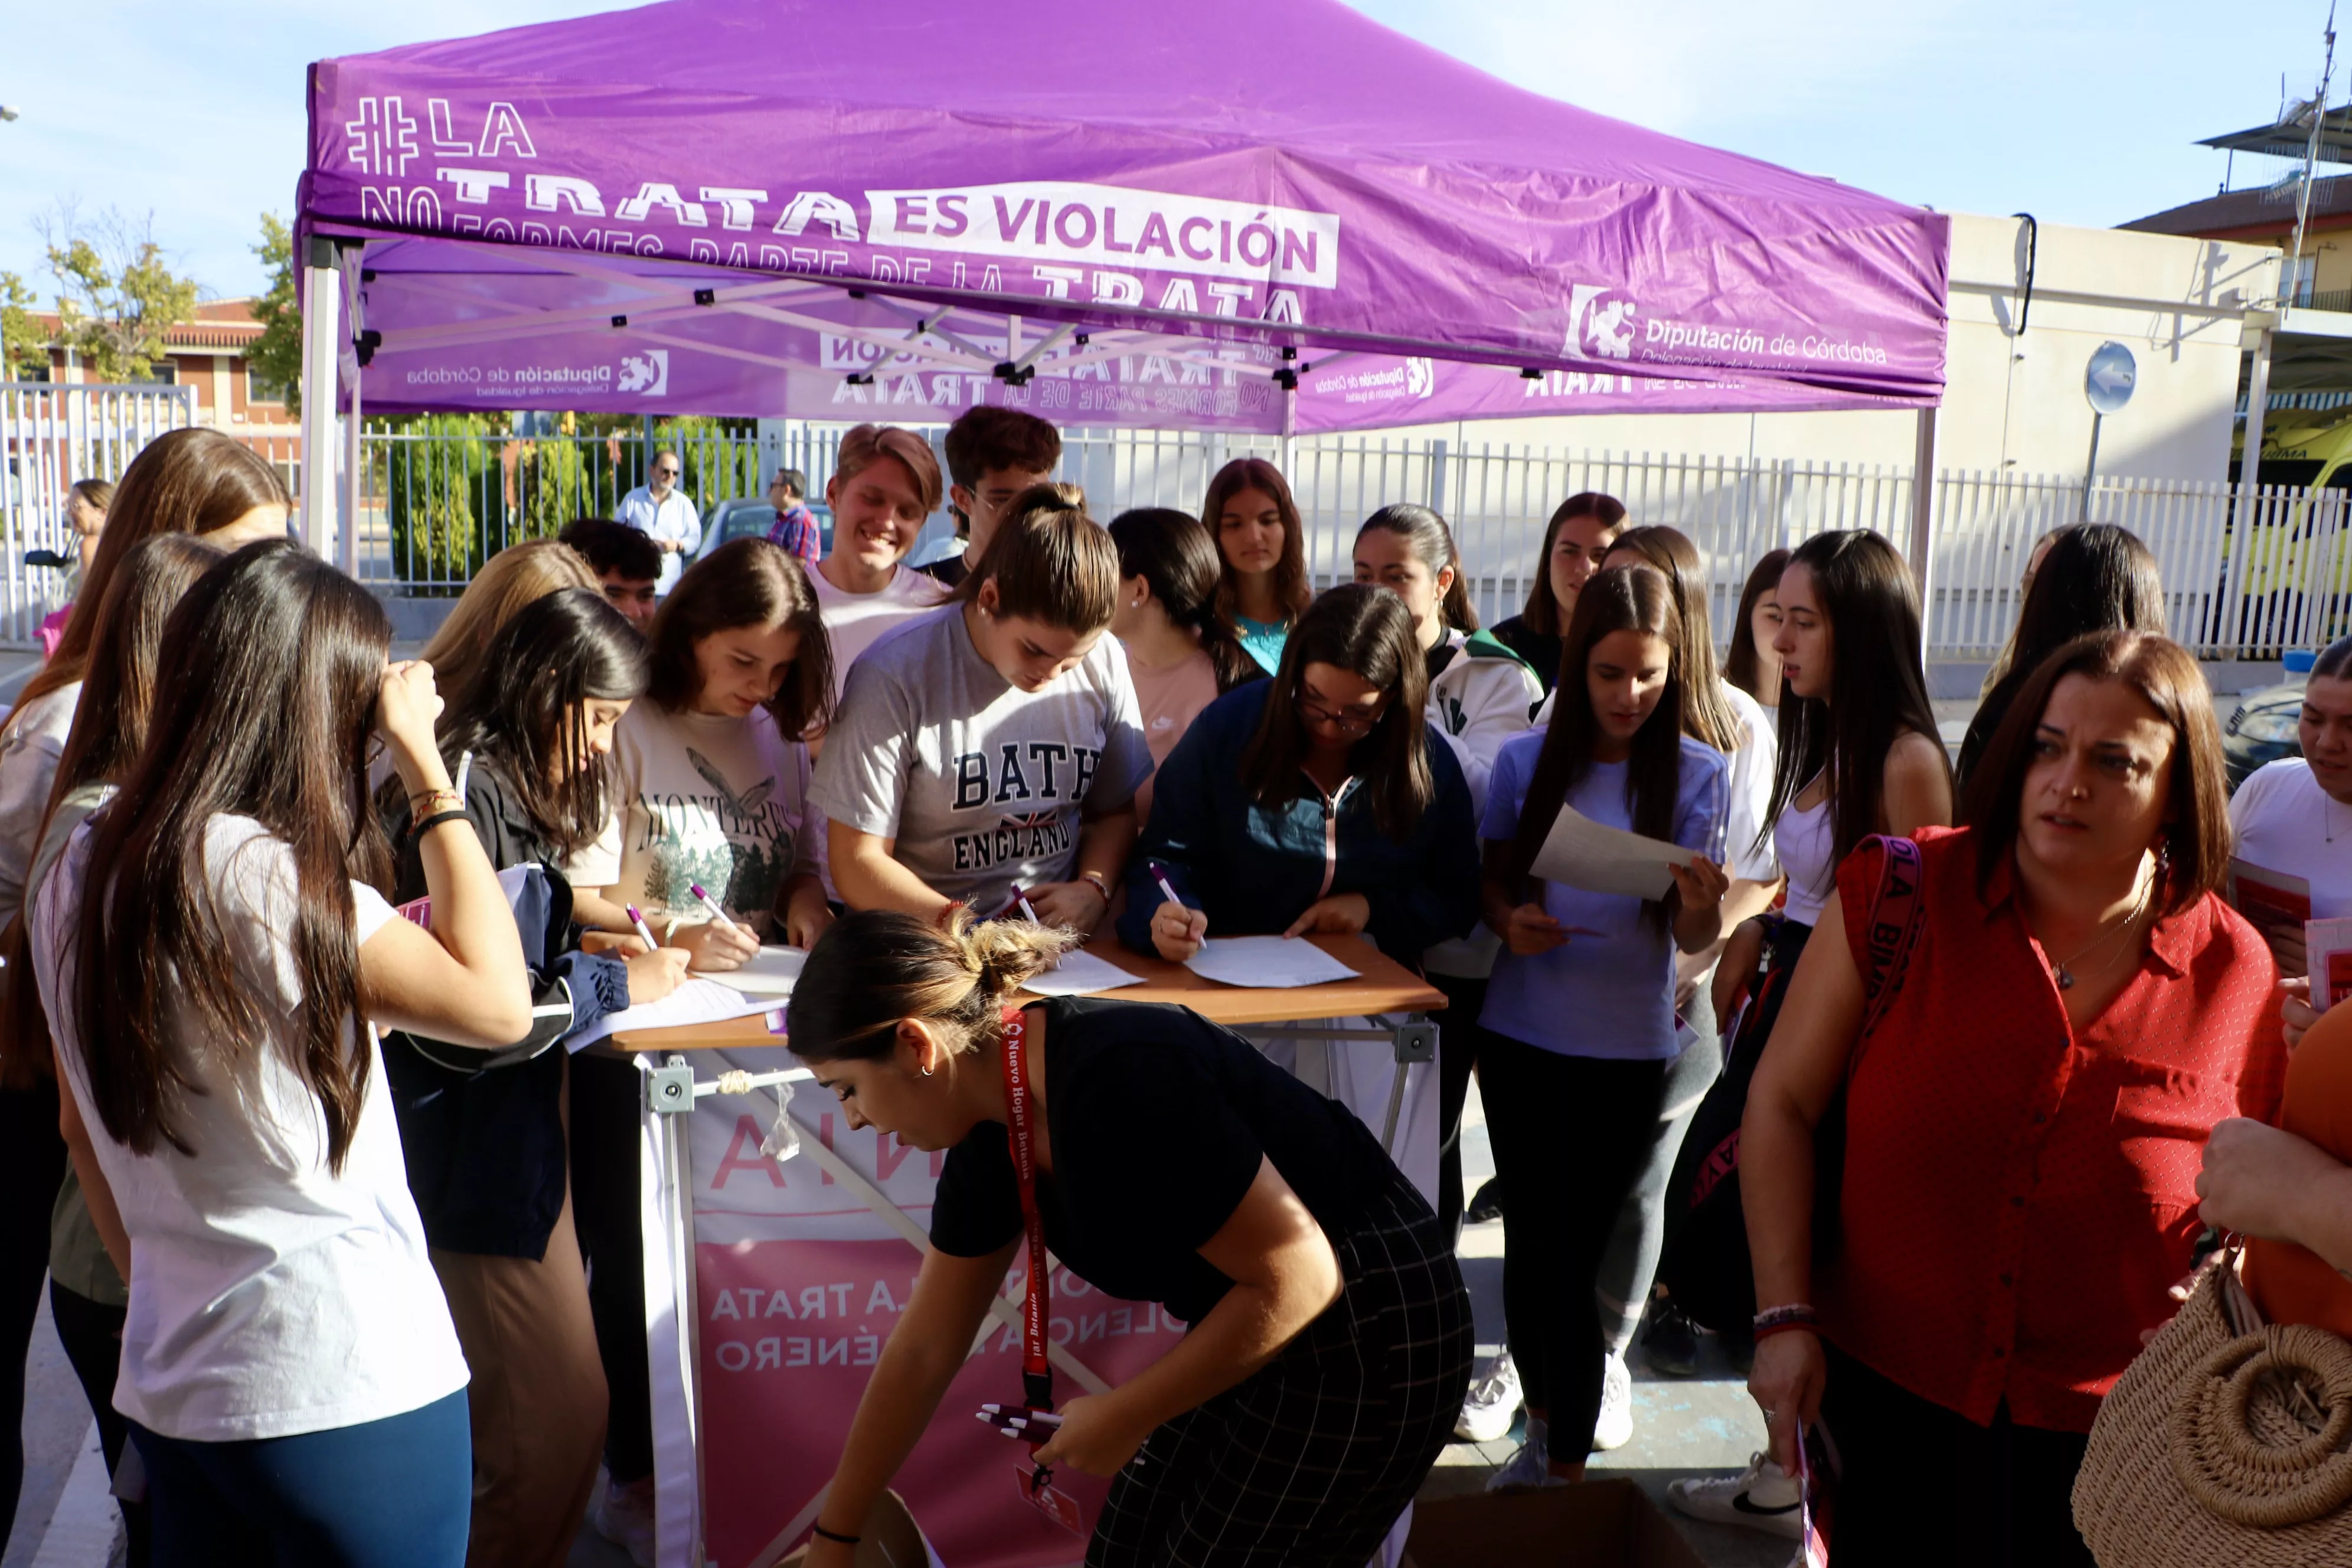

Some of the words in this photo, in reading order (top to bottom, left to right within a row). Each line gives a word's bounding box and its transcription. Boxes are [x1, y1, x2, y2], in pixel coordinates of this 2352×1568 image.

[361, 186, 442, 231] NO
[436, 167, 860, 242] TRATA
[893, 195, 968, 237] ES
[992, 195, 1318, 273] VIOLACIÓN
[1646, 319, 1765, 354] Diputación
[1770, 333, 1796, 356] de
[1802, 335, 1888, 365] Córdoba
[951, 740, 1101, 813] BATH
[952, 819, 1071, 871] ENGLAND
[1008, 1040, 1020, 1084] Nuevo
[1012, 1086, 1024, 1127] Hogar
[1017, 1131, 1030, 1181] Betania
[1030, 1292, 1039, 1337] Betania
